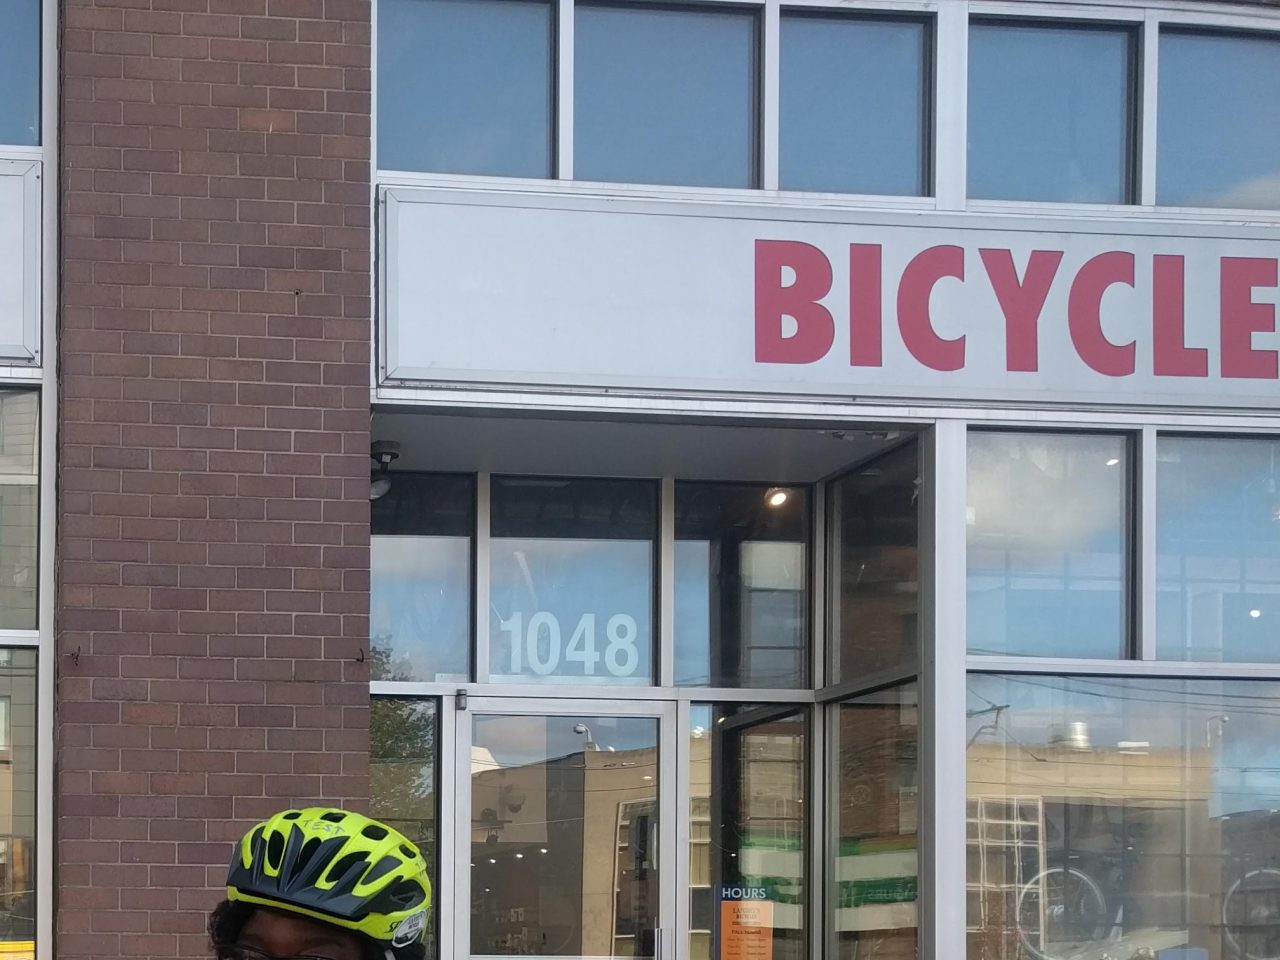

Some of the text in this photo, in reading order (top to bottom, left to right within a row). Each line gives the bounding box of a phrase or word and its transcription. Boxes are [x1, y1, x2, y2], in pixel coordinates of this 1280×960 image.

[754, 238, 1279, 379] BICYCLE
[500, 610, 639, 677] 1048
[302, 819, 346, 834] TEST
[722, 887, 767, 899] HOURS
